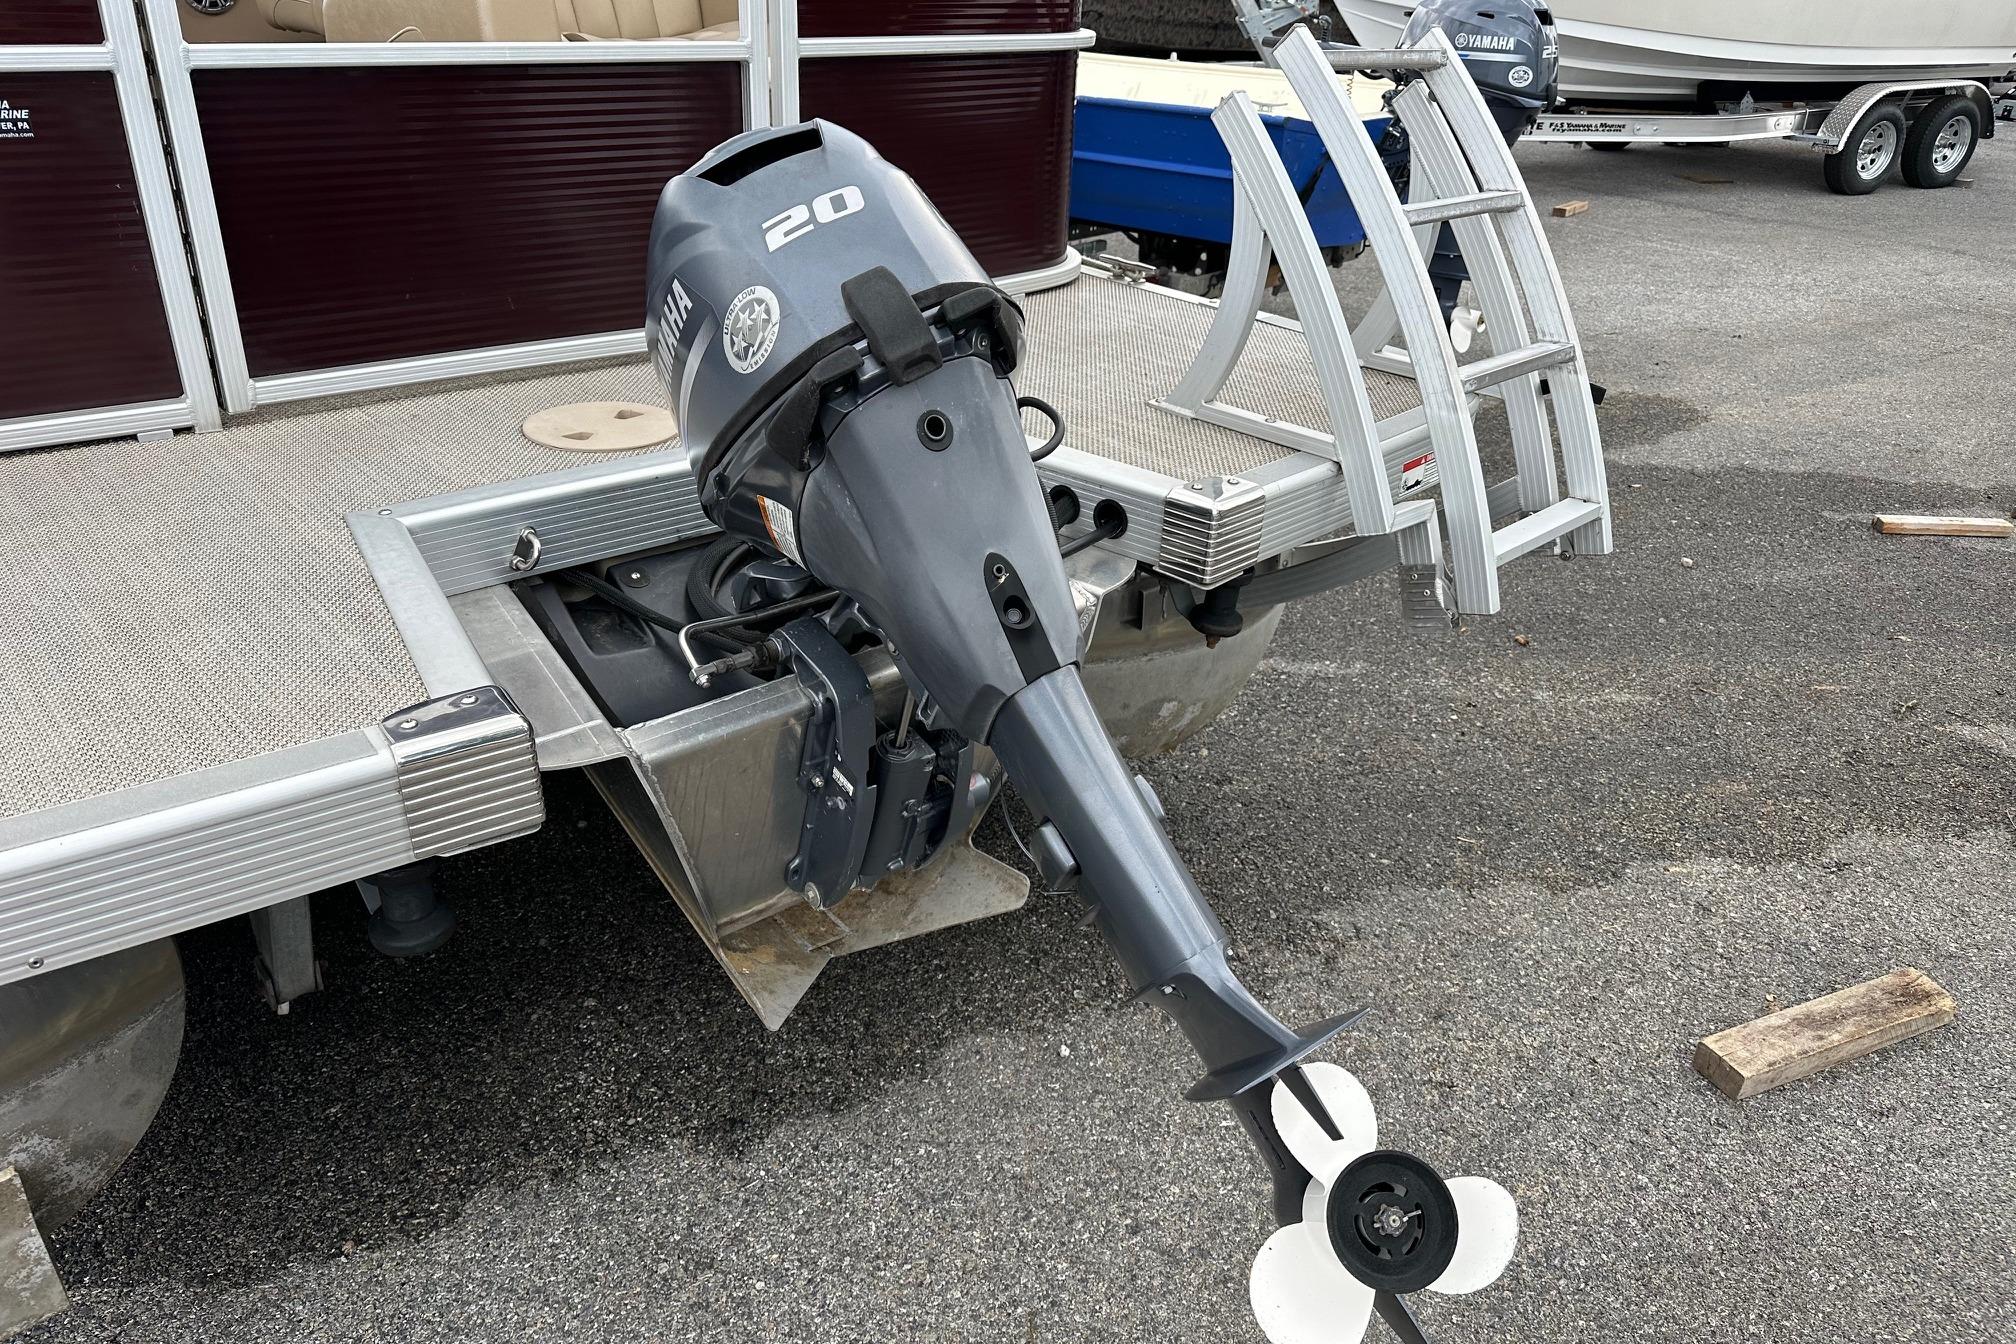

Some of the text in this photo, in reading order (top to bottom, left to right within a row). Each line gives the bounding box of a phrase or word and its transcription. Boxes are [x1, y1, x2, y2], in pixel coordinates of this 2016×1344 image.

[1468, 34, 1516, 50] YAMAHA
[0, 121, 30, 131] ER, PA
[761, 185, 865, 253] 20
[750, 329, 777, 370] EMISSION
